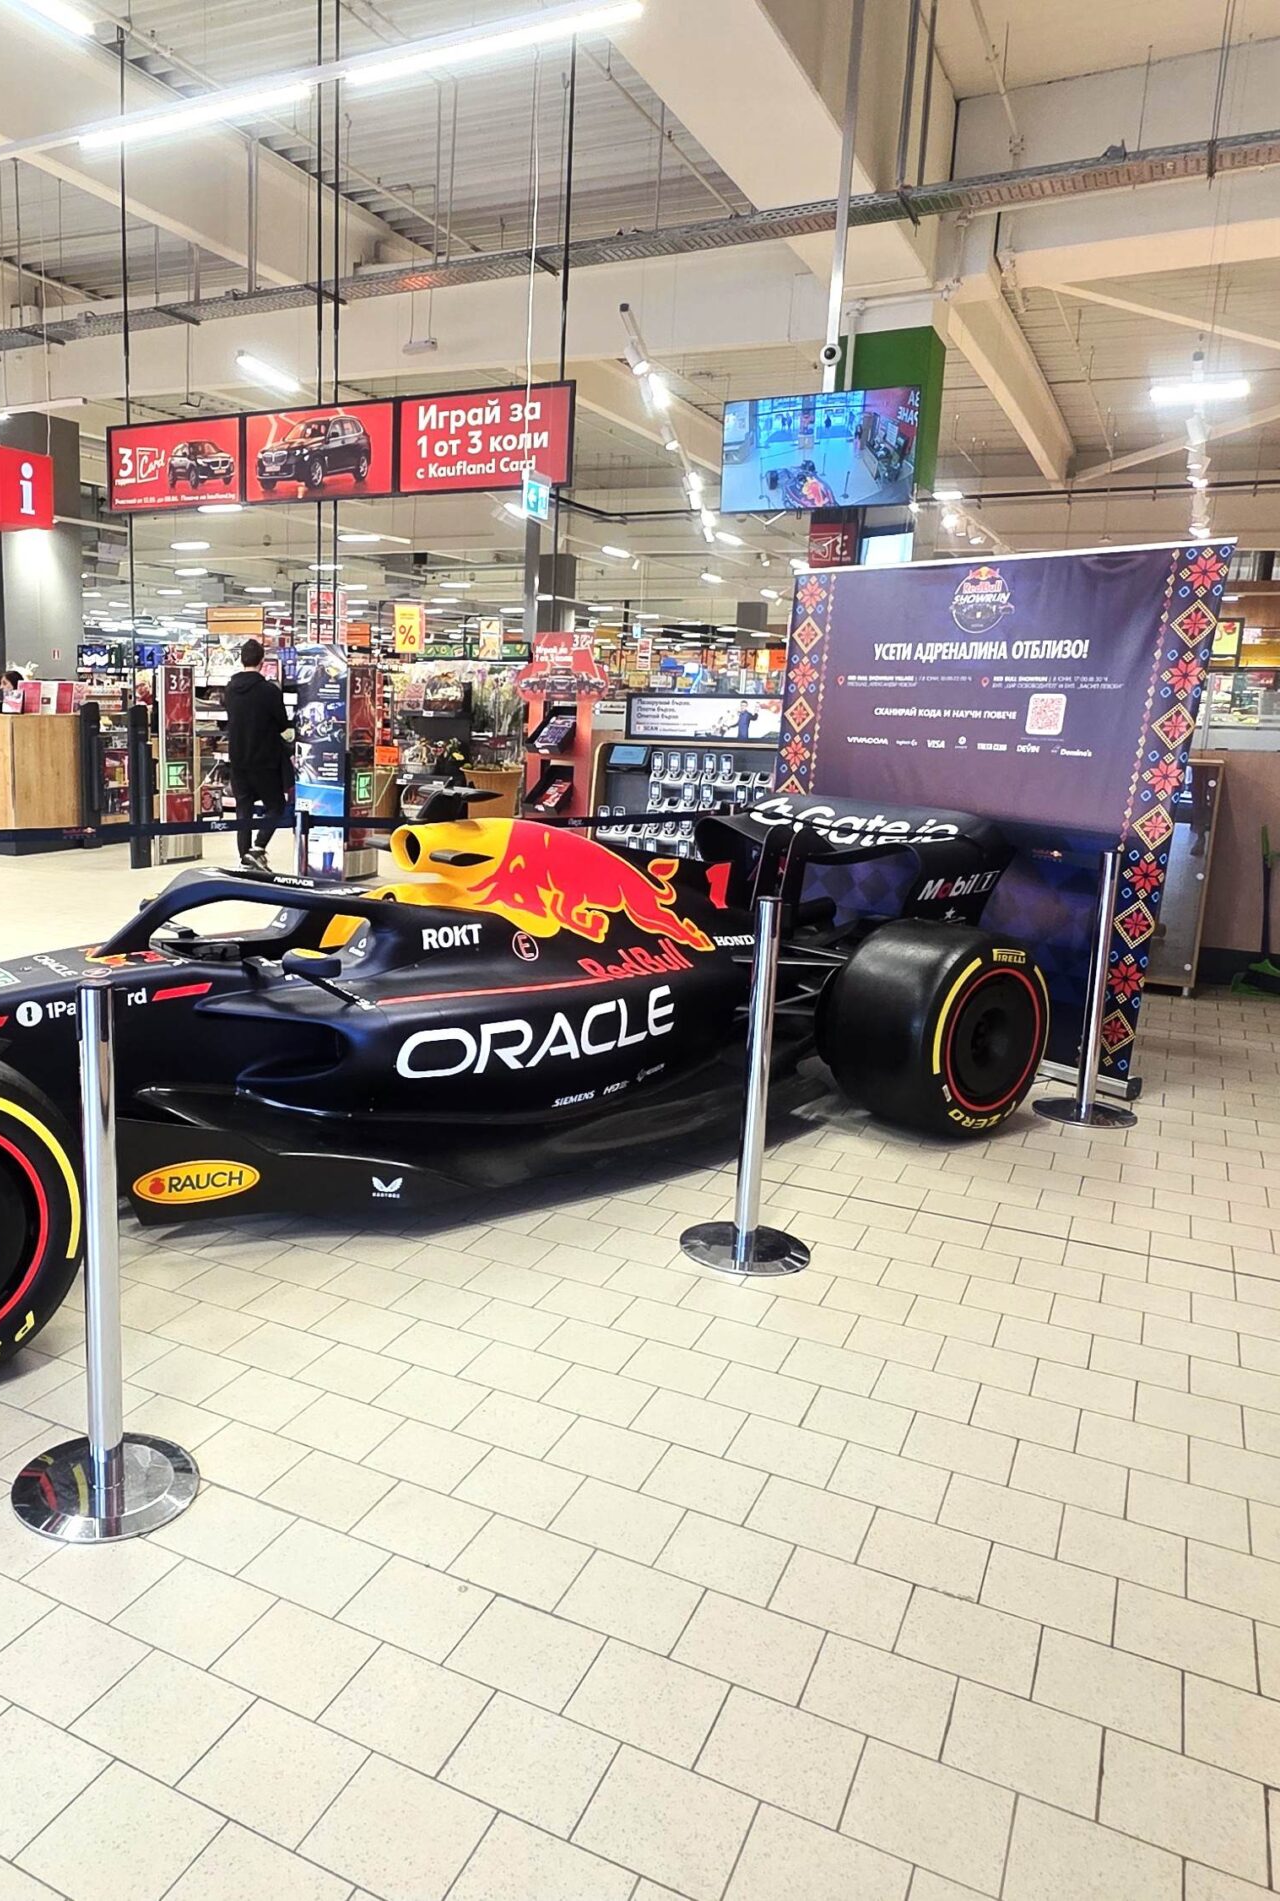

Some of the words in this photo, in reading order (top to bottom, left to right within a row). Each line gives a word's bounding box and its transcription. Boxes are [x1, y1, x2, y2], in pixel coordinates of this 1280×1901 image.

[417, 400, 501, 434] Играй
[509, 401, 541, 422] за
[417, 435, 428, 459] 1
[434, 439, 461, 457] от
[467, 430, 483, 455] 3
[489, 431, 549, 453] коли
[118, 447, 133, 478] 3
[428, 459, 496, 478] Kaufland
[499, 455, 537, 473] Card
[951, 592, 1011, 605] SHOWRUN
[874, 643, 911, 661] УСЕТИ
[914, 641, 1008, 662] АДРЕНАЛИНА
[1012, 639, 1089, 660] ОТБЛИЗО!
[918, 708, 941, 718] КОДА
[943, 709, 950, 717] И
[952, 709, 981, 718] НАУЧИ
[983, 710, 1017, 719] ПОВЕЧЕ
[917, 874, 981, 901] Mobil
[422, 923, 482, 950] ROKT
[714, 934, 756, 946] HOND
[992, 948, 1026, 964] PIRELLI
[396, 985, 675, 1078] ORACLE
[551, 1090, 595, 1107] SIEMENS
[948, 1108, 1002, 1130] ZERO
[167, 1170, 244, 1193] RAUCH
[14, 1310, 35, 1342] P
